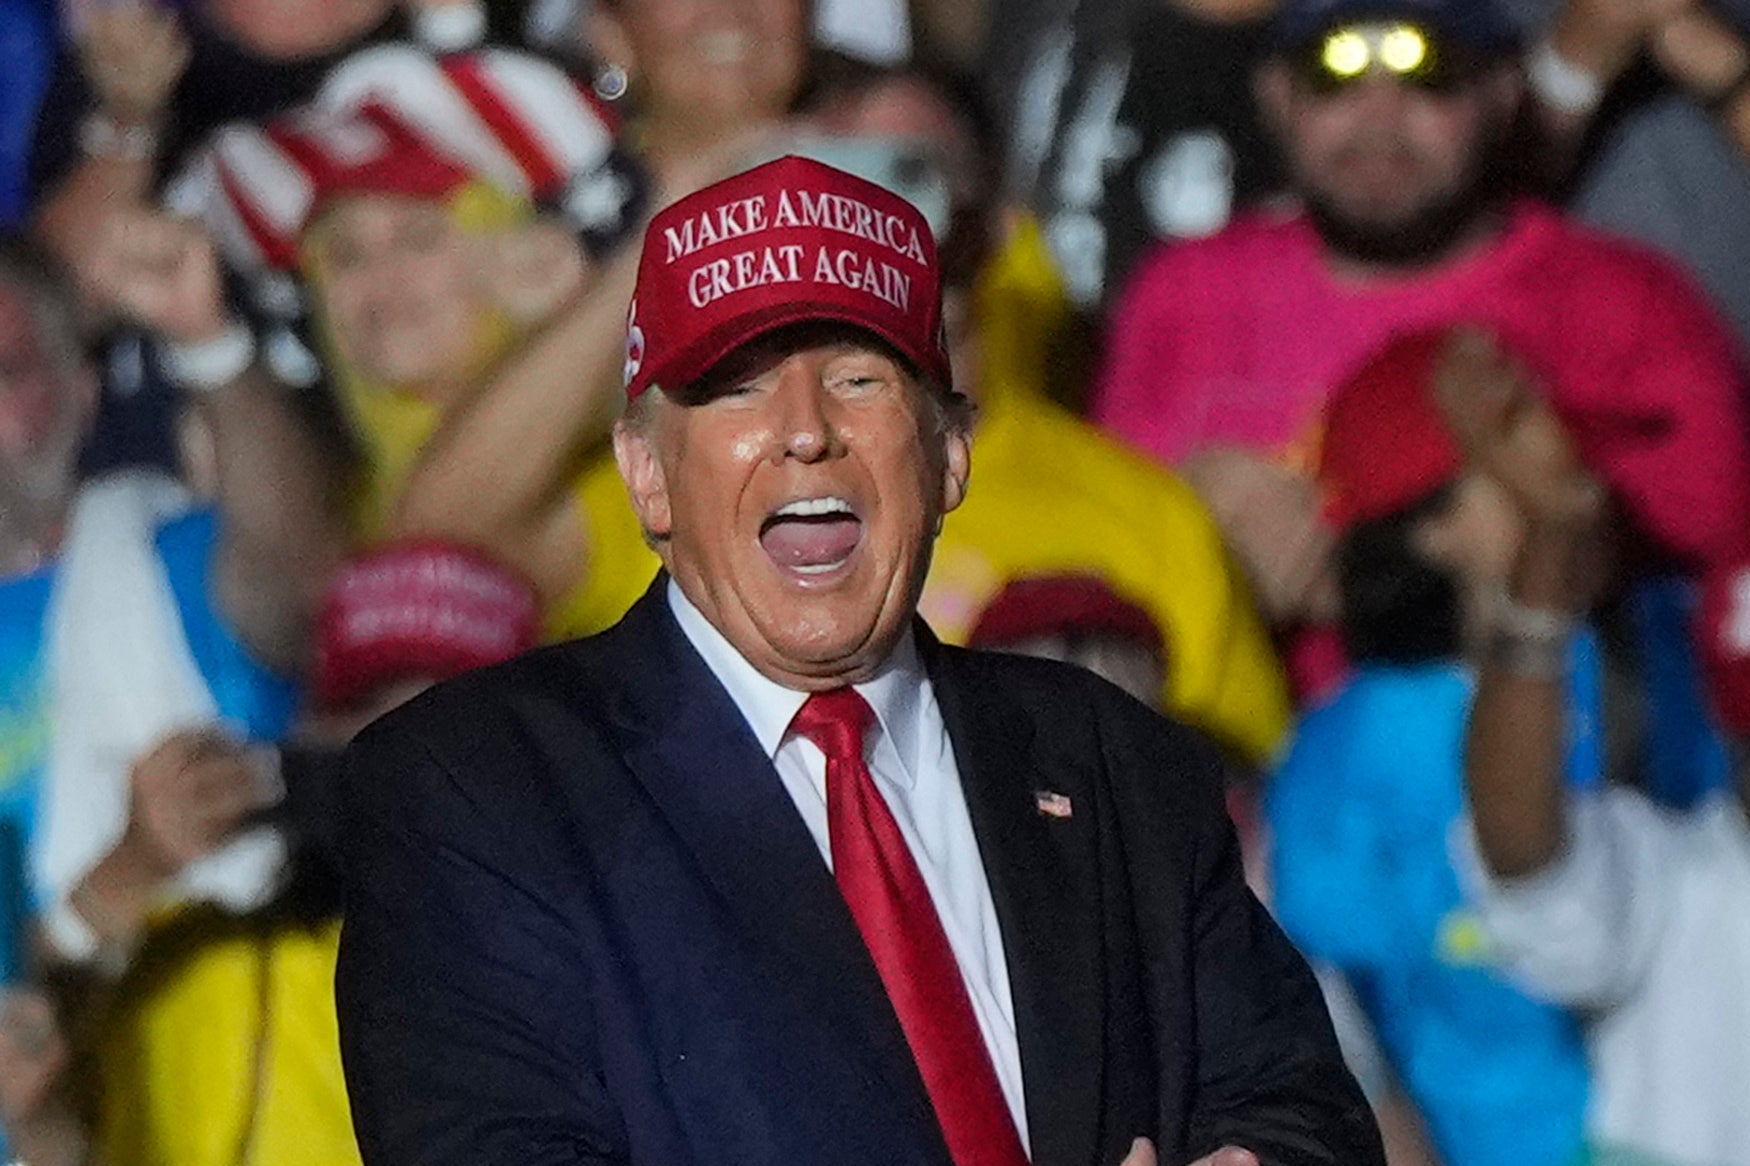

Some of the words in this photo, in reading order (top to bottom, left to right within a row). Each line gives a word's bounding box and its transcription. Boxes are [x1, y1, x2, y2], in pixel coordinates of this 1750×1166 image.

[664, 195, 768, 264] MAKE
[774, 189, 928, 266] AMERICA
[688, 245, 804, 308] GREAT
[814, 246, 910, 312] AGAIN
